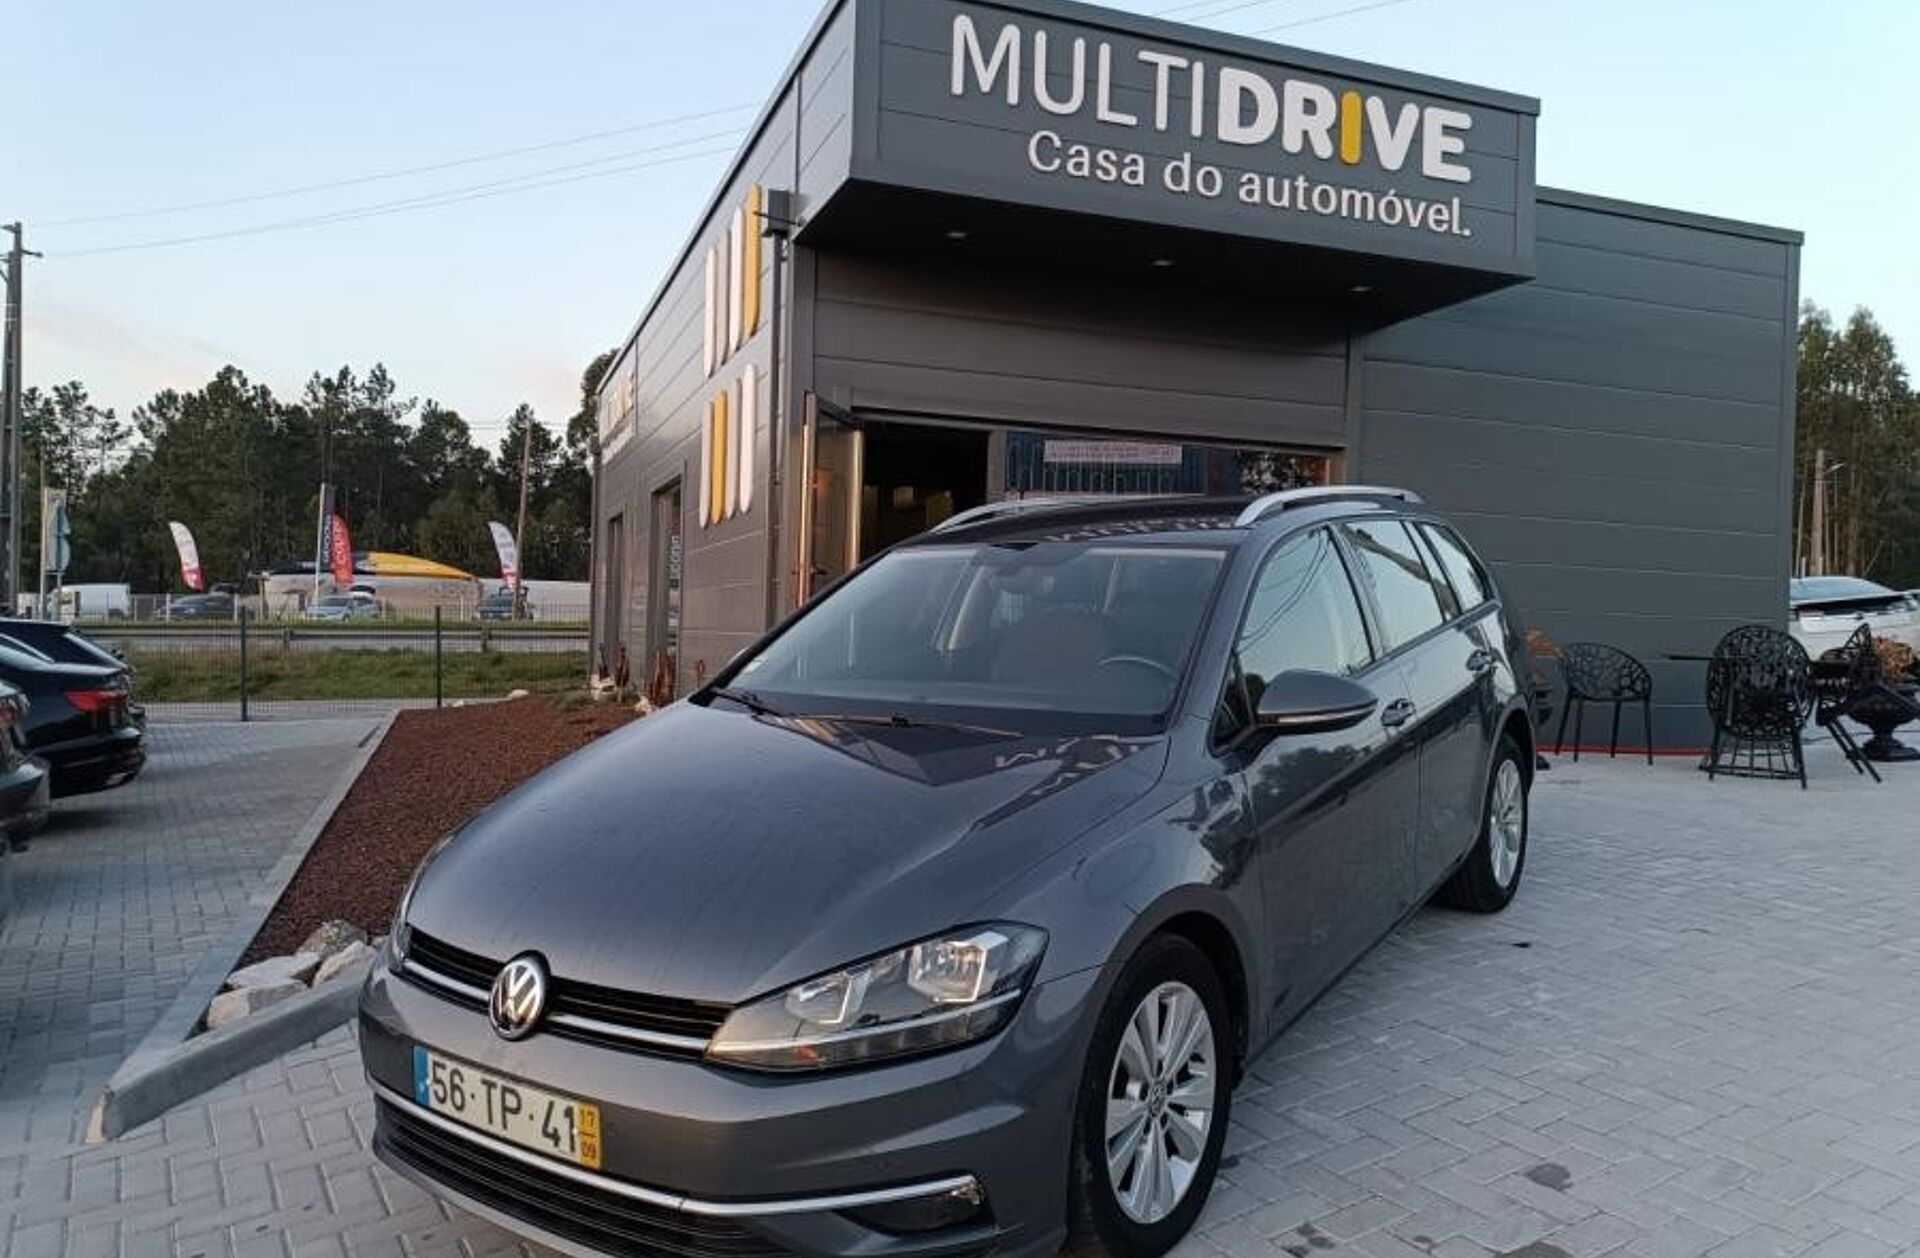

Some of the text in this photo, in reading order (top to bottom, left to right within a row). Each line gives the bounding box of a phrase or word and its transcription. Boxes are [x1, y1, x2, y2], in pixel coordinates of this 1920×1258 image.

[951, 14, 1472, 183] MULTIDRIVE
[1028, 130, 1472, 237] Casa do automóvel.
